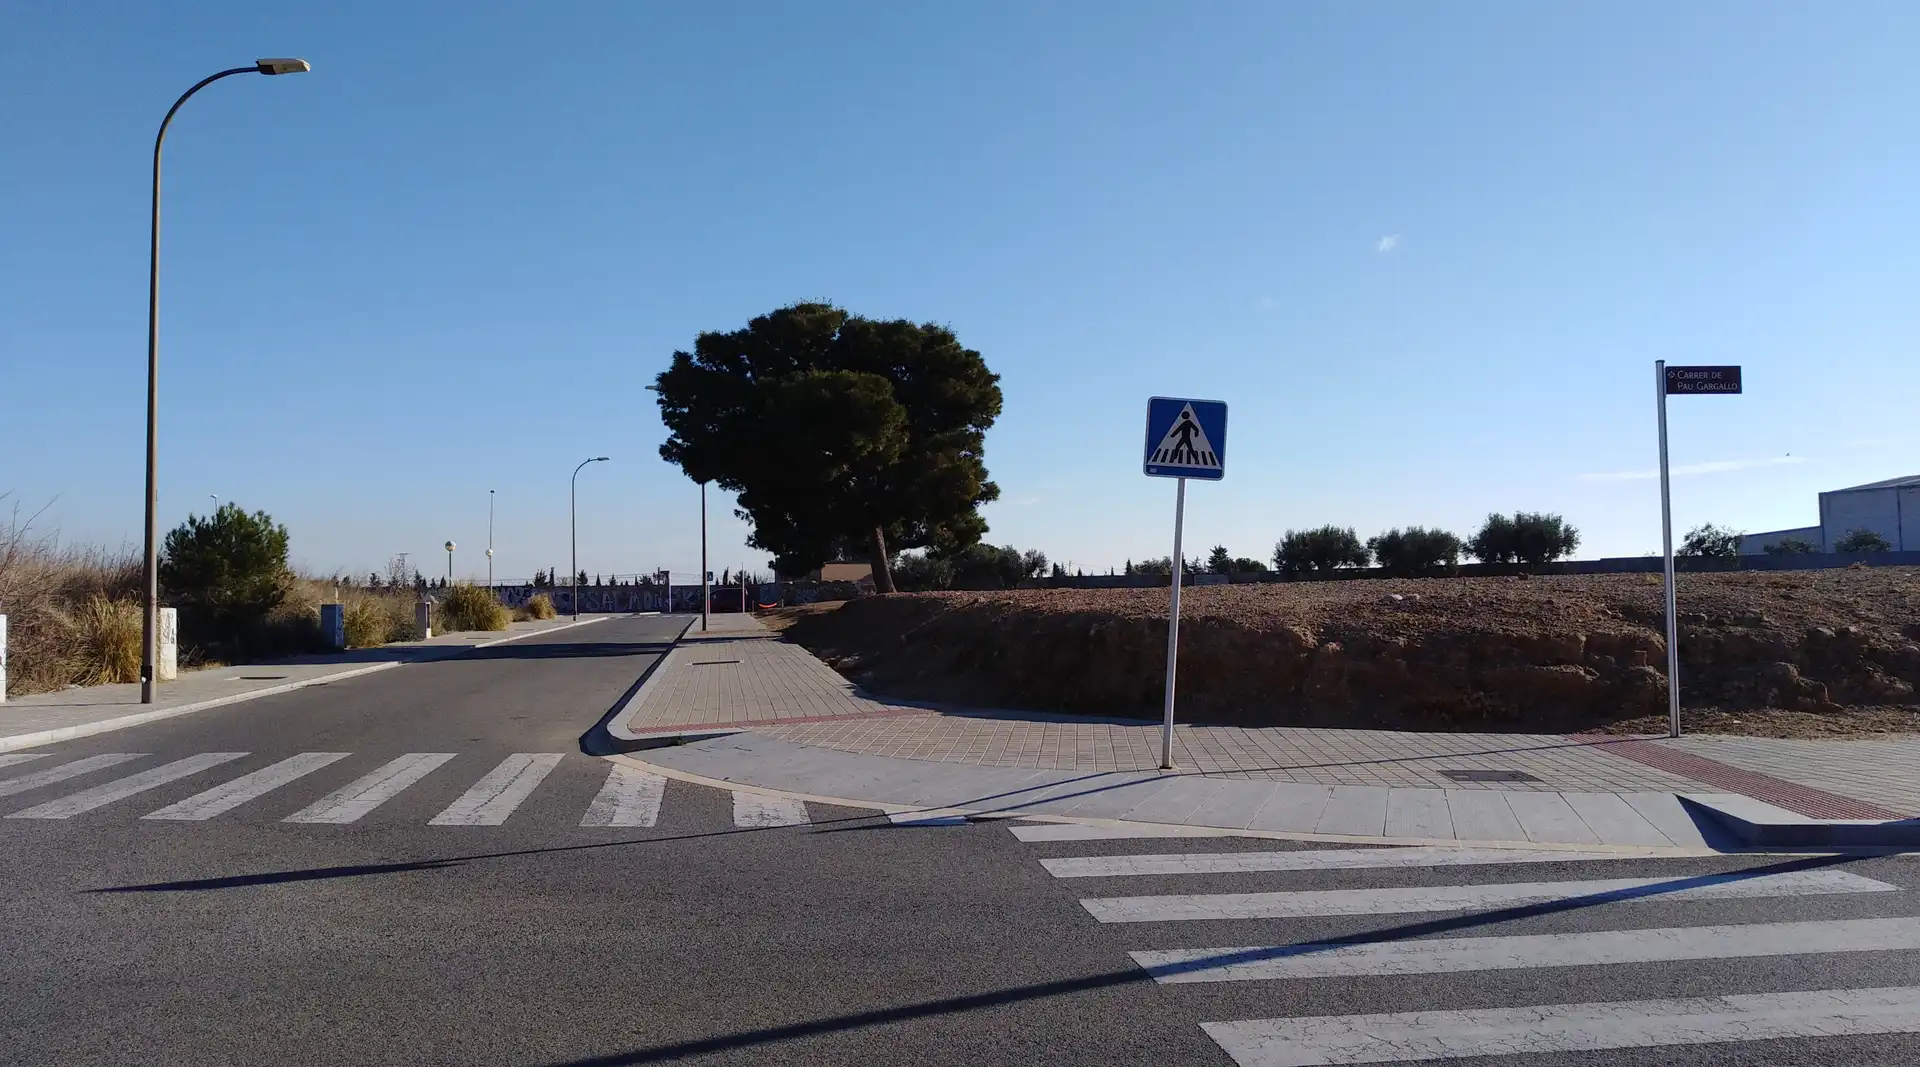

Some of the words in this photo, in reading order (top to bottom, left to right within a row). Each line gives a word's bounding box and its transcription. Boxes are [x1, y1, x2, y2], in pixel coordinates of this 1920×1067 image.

[1677, 370, 1709, 379] CARRER
[1711, 371, 1722, 379] DE
[1677, 381, 1694, 391] PAU
